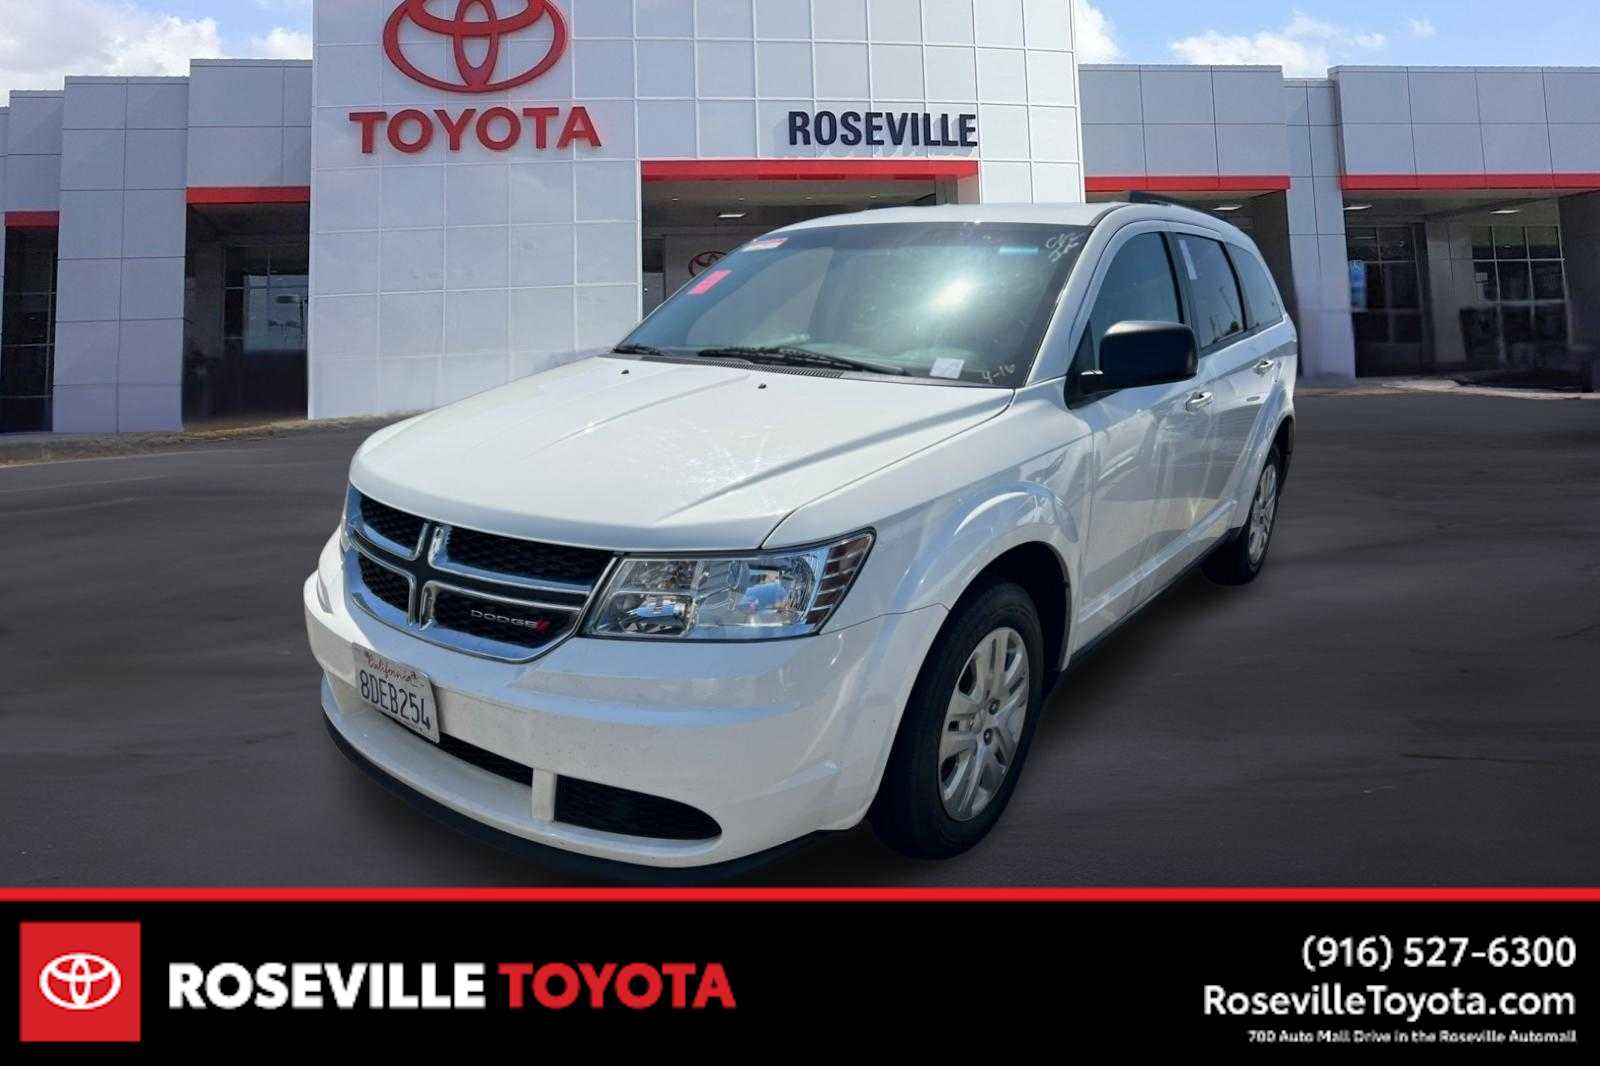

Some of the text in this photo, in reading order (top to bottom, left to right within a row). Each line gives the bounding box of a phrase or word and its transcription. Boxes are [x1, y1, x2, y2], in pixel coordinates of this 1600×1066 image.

[350, 106, 602, 154] TOYOTA
[788, 110, 978, 147] ROSEVILLE
[470, 609, 538, 630] DODGE
[360, 669, 431, 730] 8DEB254
